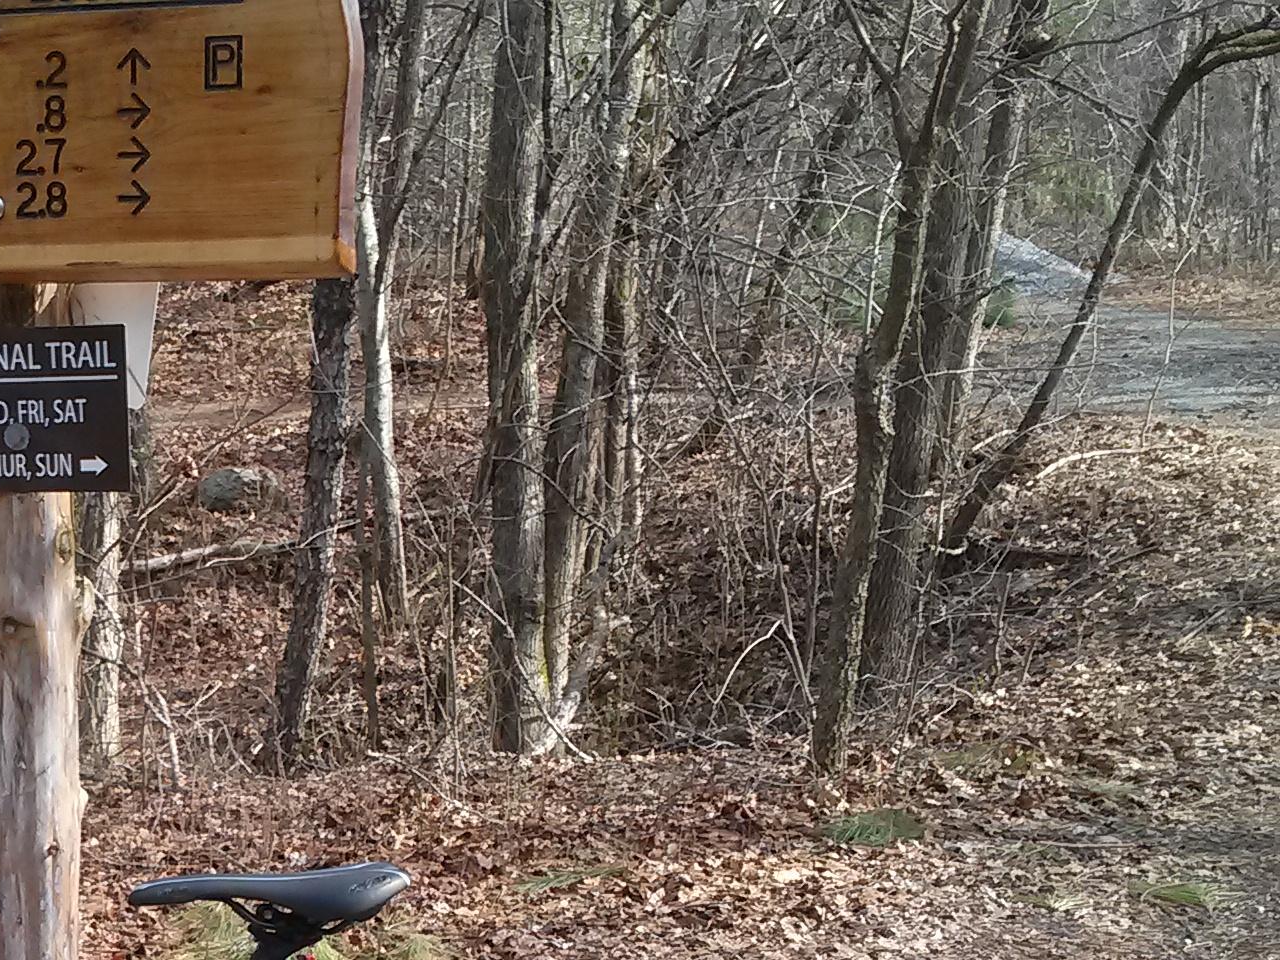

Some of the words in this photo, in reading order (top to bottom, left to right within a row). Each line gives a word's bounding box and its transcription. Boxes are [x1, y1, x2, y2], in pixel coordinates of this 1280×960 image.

[35, 50, 68, 89] .2
[211, 43, 236, 84] P
[36, 95, 67, 133] .8
[16, 138, 67, 176] 2.7
[16, 181, 68, 219] 2.8
[45, 340, 117, 370] TRAIL
[18, 399, 49, 427] FRI,
[53, 398, 87, 424] SAT
[35, 452, 73, 478] SUN
